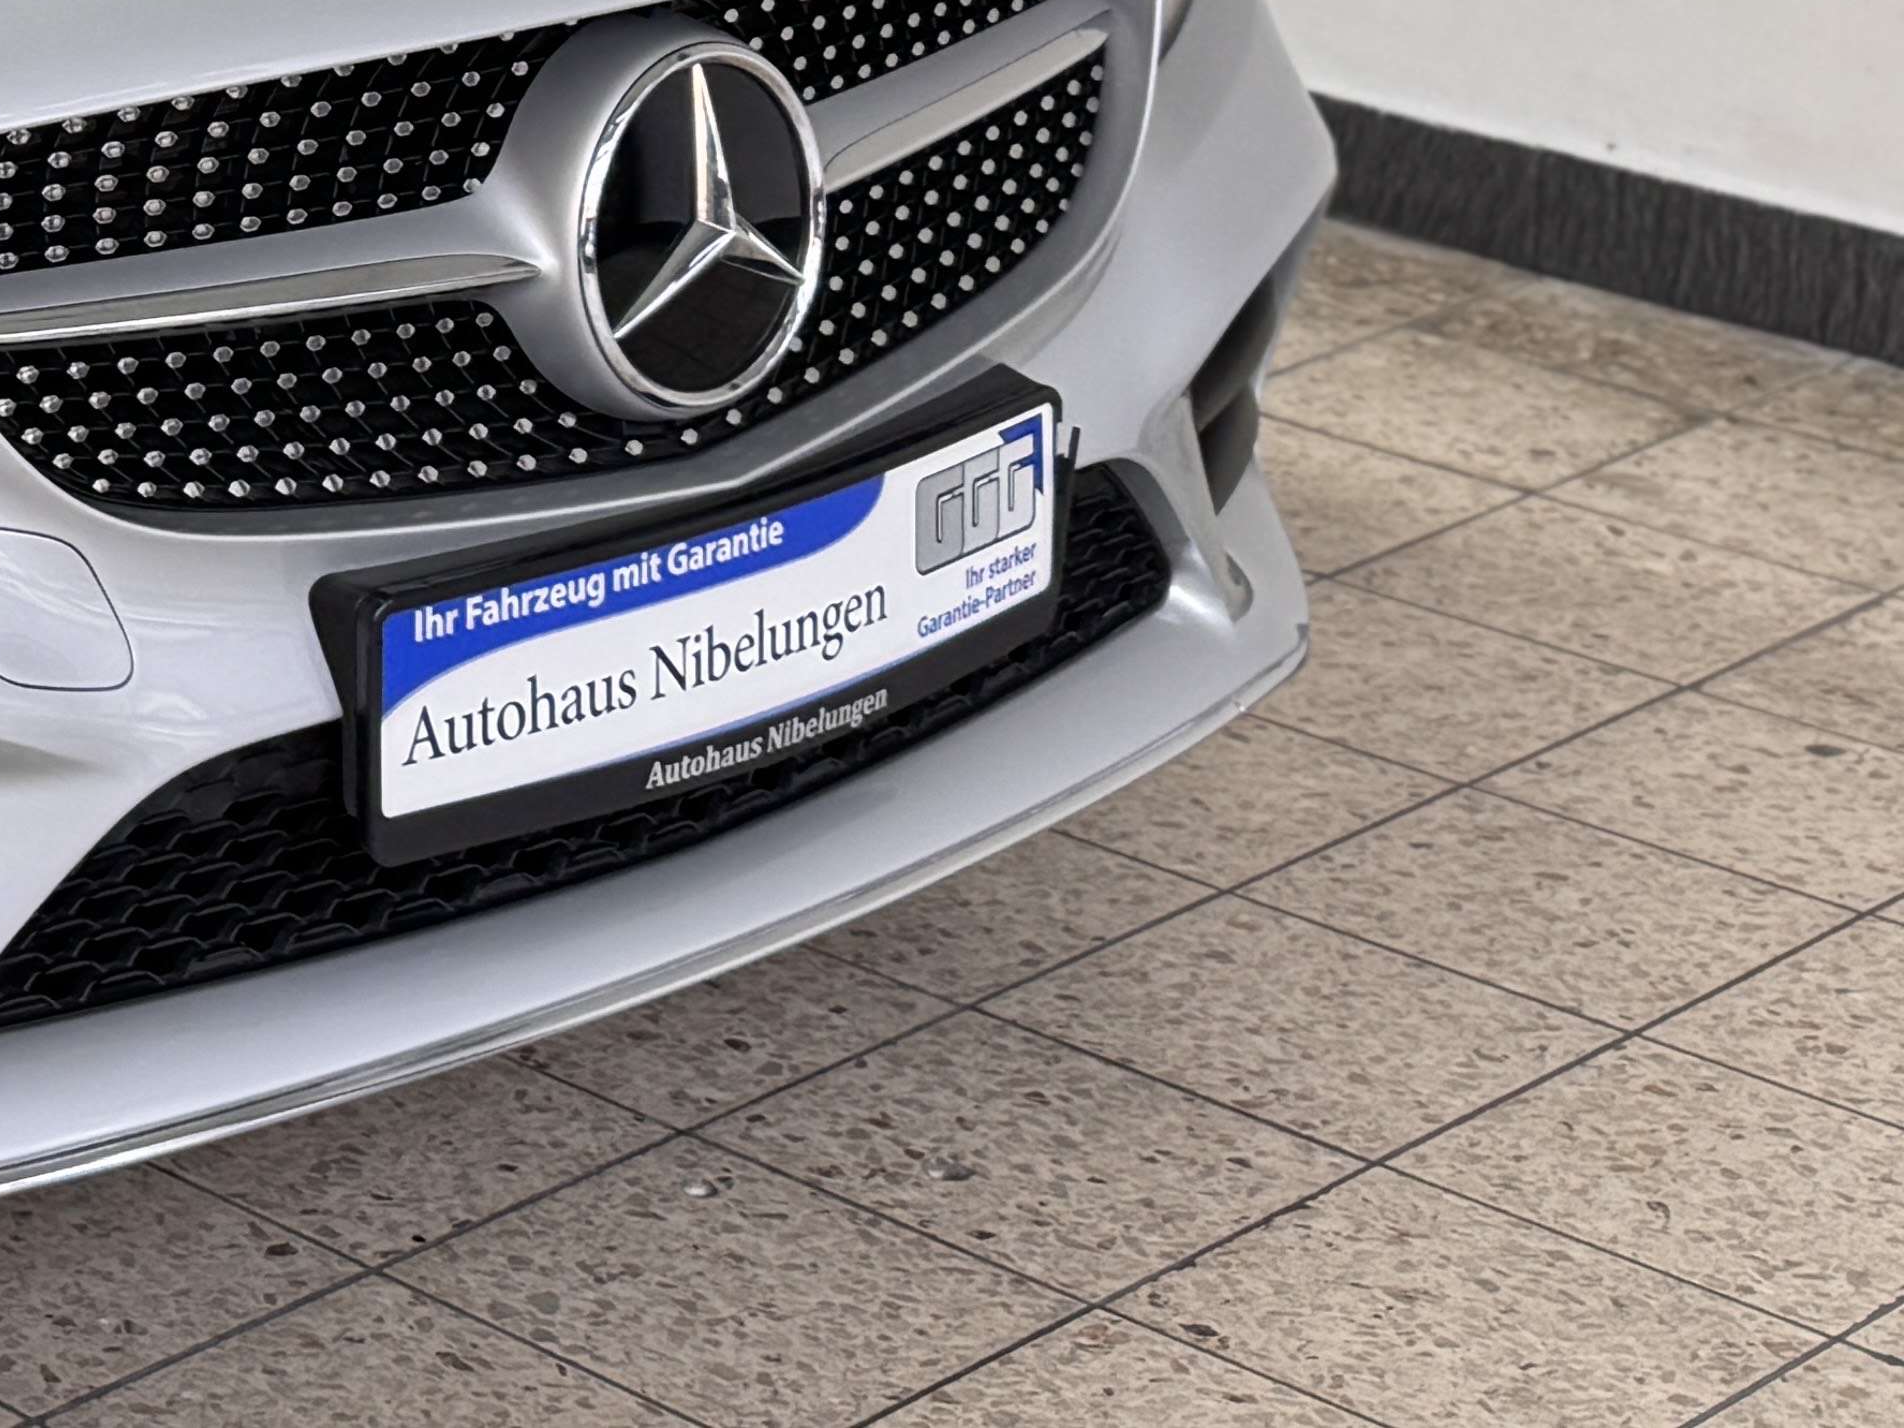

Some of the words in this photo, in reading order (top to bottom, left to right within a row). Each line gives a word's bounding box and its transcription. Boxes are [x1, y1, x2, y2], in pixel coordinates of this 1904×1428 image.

[413, 608, 459, 643] Ihr
[465, 572, 606, 631] Fahrzeug
[612, 551, 662, 593] mit
[666, 517, 784, 577] Garantie
[916, 570, 1037, 639] Garantie-Partner
[965, 566, 985, 590] Ihr
[988, 542, 1037, 580] starker
[402, 667, 639, 766] Autohaus
[649, 584, 888, 700] Nibelungen
[645, 737, 763, 790] Autohaus
[766, 685, 888, 754] Nibelungen
